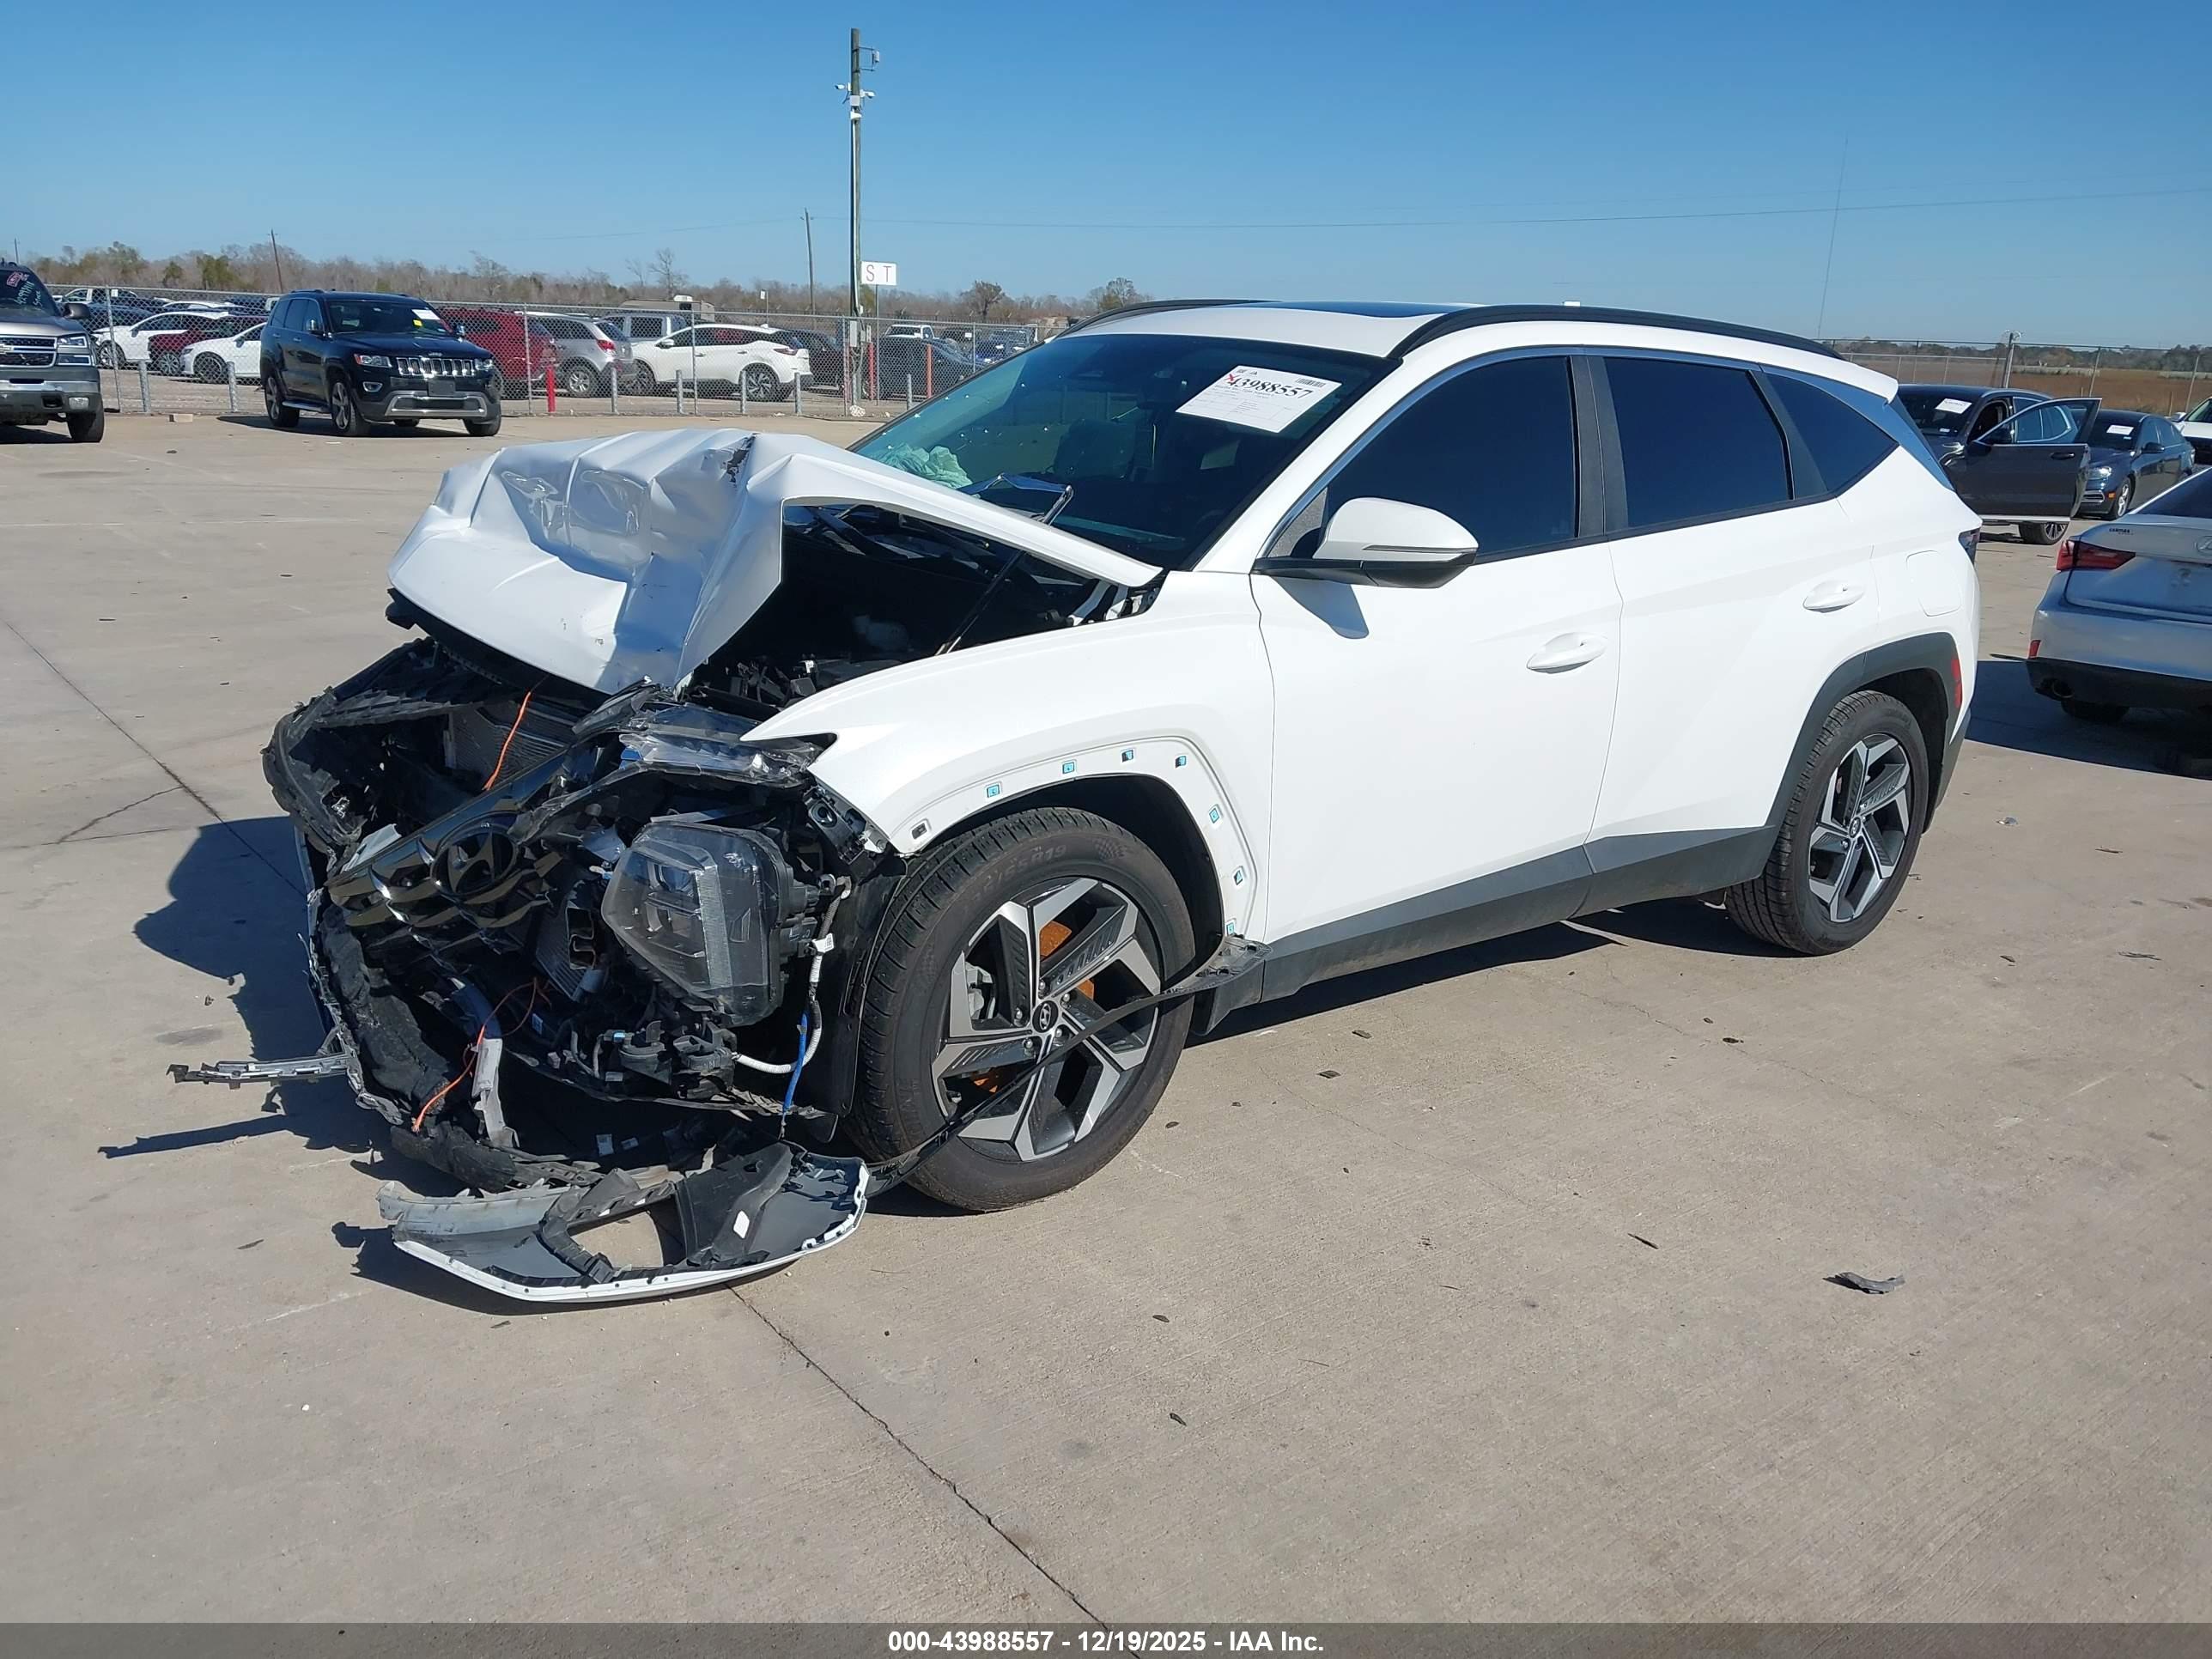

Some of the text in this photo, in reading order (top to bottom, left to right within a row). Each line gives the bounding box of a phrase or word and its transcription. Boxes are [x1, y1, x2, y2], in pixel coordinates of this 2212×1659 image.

[866, 264, 893, 283] S T
[1227, 377, 1314, 398] 43988557
